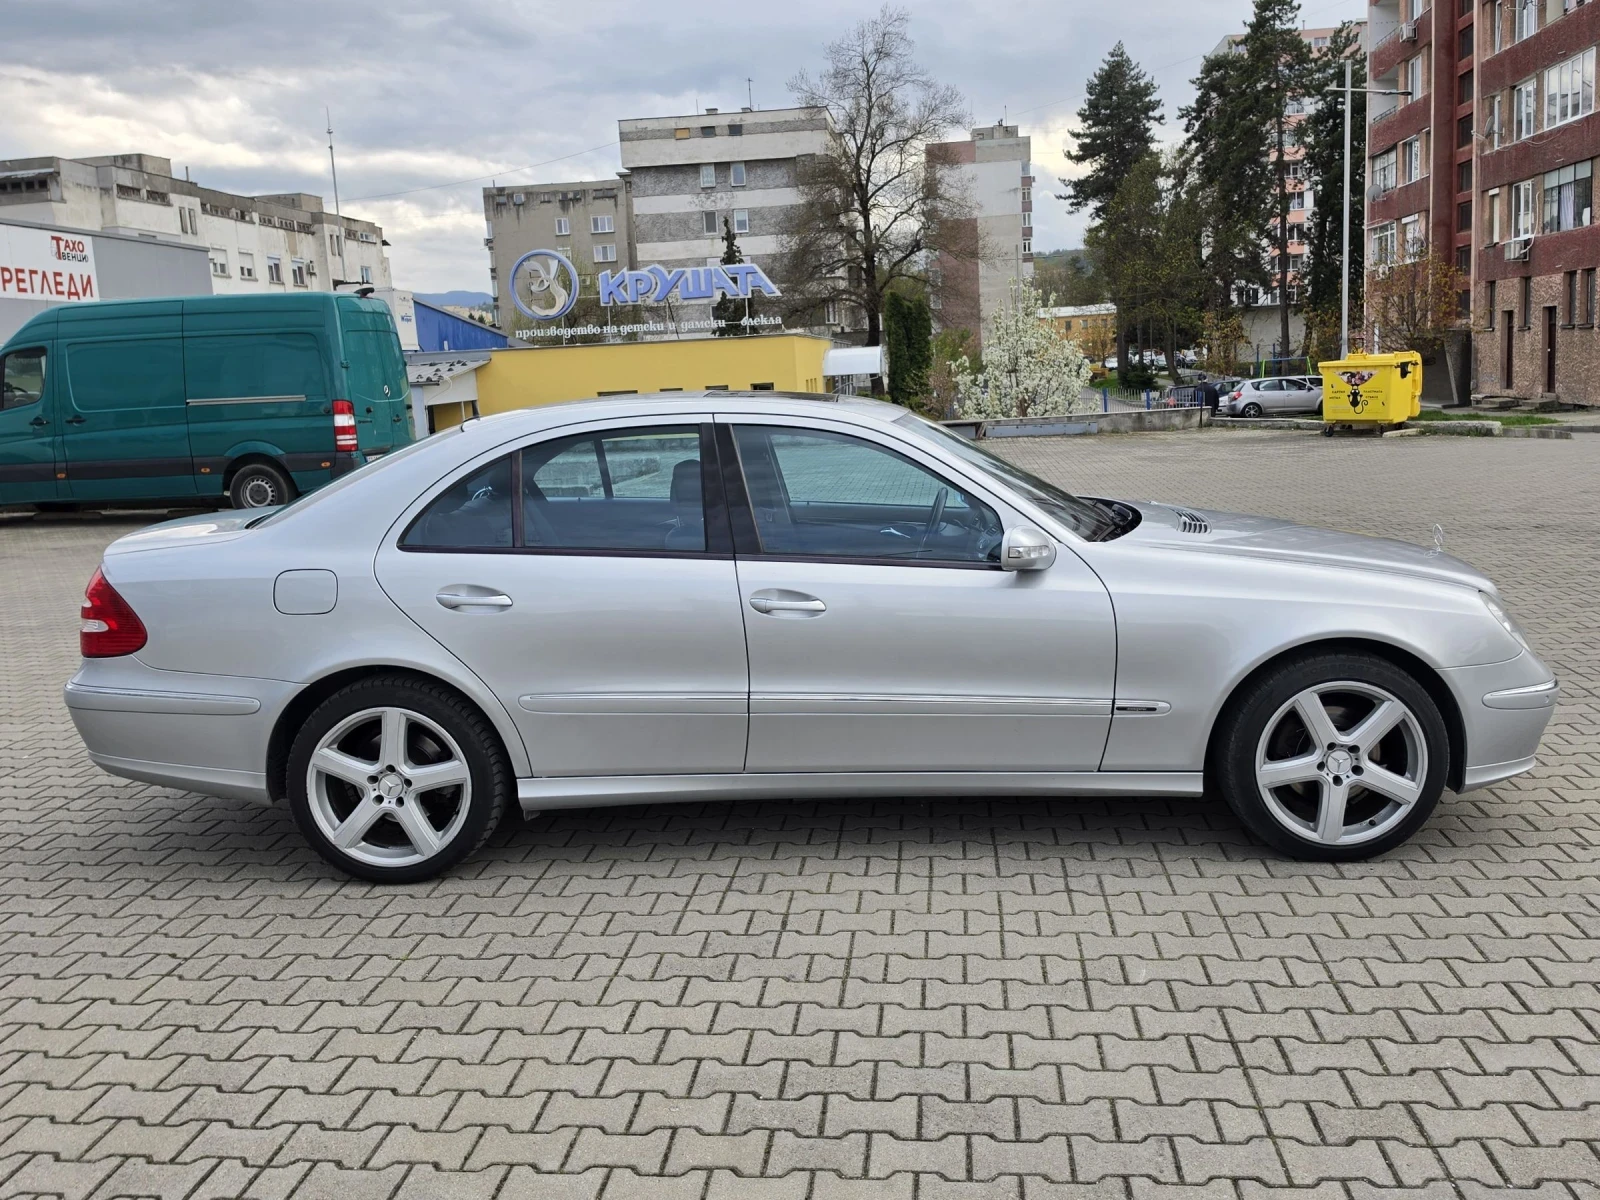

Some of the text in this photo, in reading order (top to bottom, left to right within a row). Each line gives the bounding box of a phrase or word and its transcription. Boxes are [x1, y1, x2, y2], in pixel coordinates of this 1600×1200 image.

[51, 236, 84, 260] ТАХО
[0, 266, 94, 300] РЕГЛЕДИ
[599, 264, 781, 305] КРУШАТА
[515, 324, 600, 339] производство
[603, 325, 618, 334] на
[619, 320, 664, 336] детски
[668, 321, 677, 330] и
[681, 317, 726, 332] дамски
